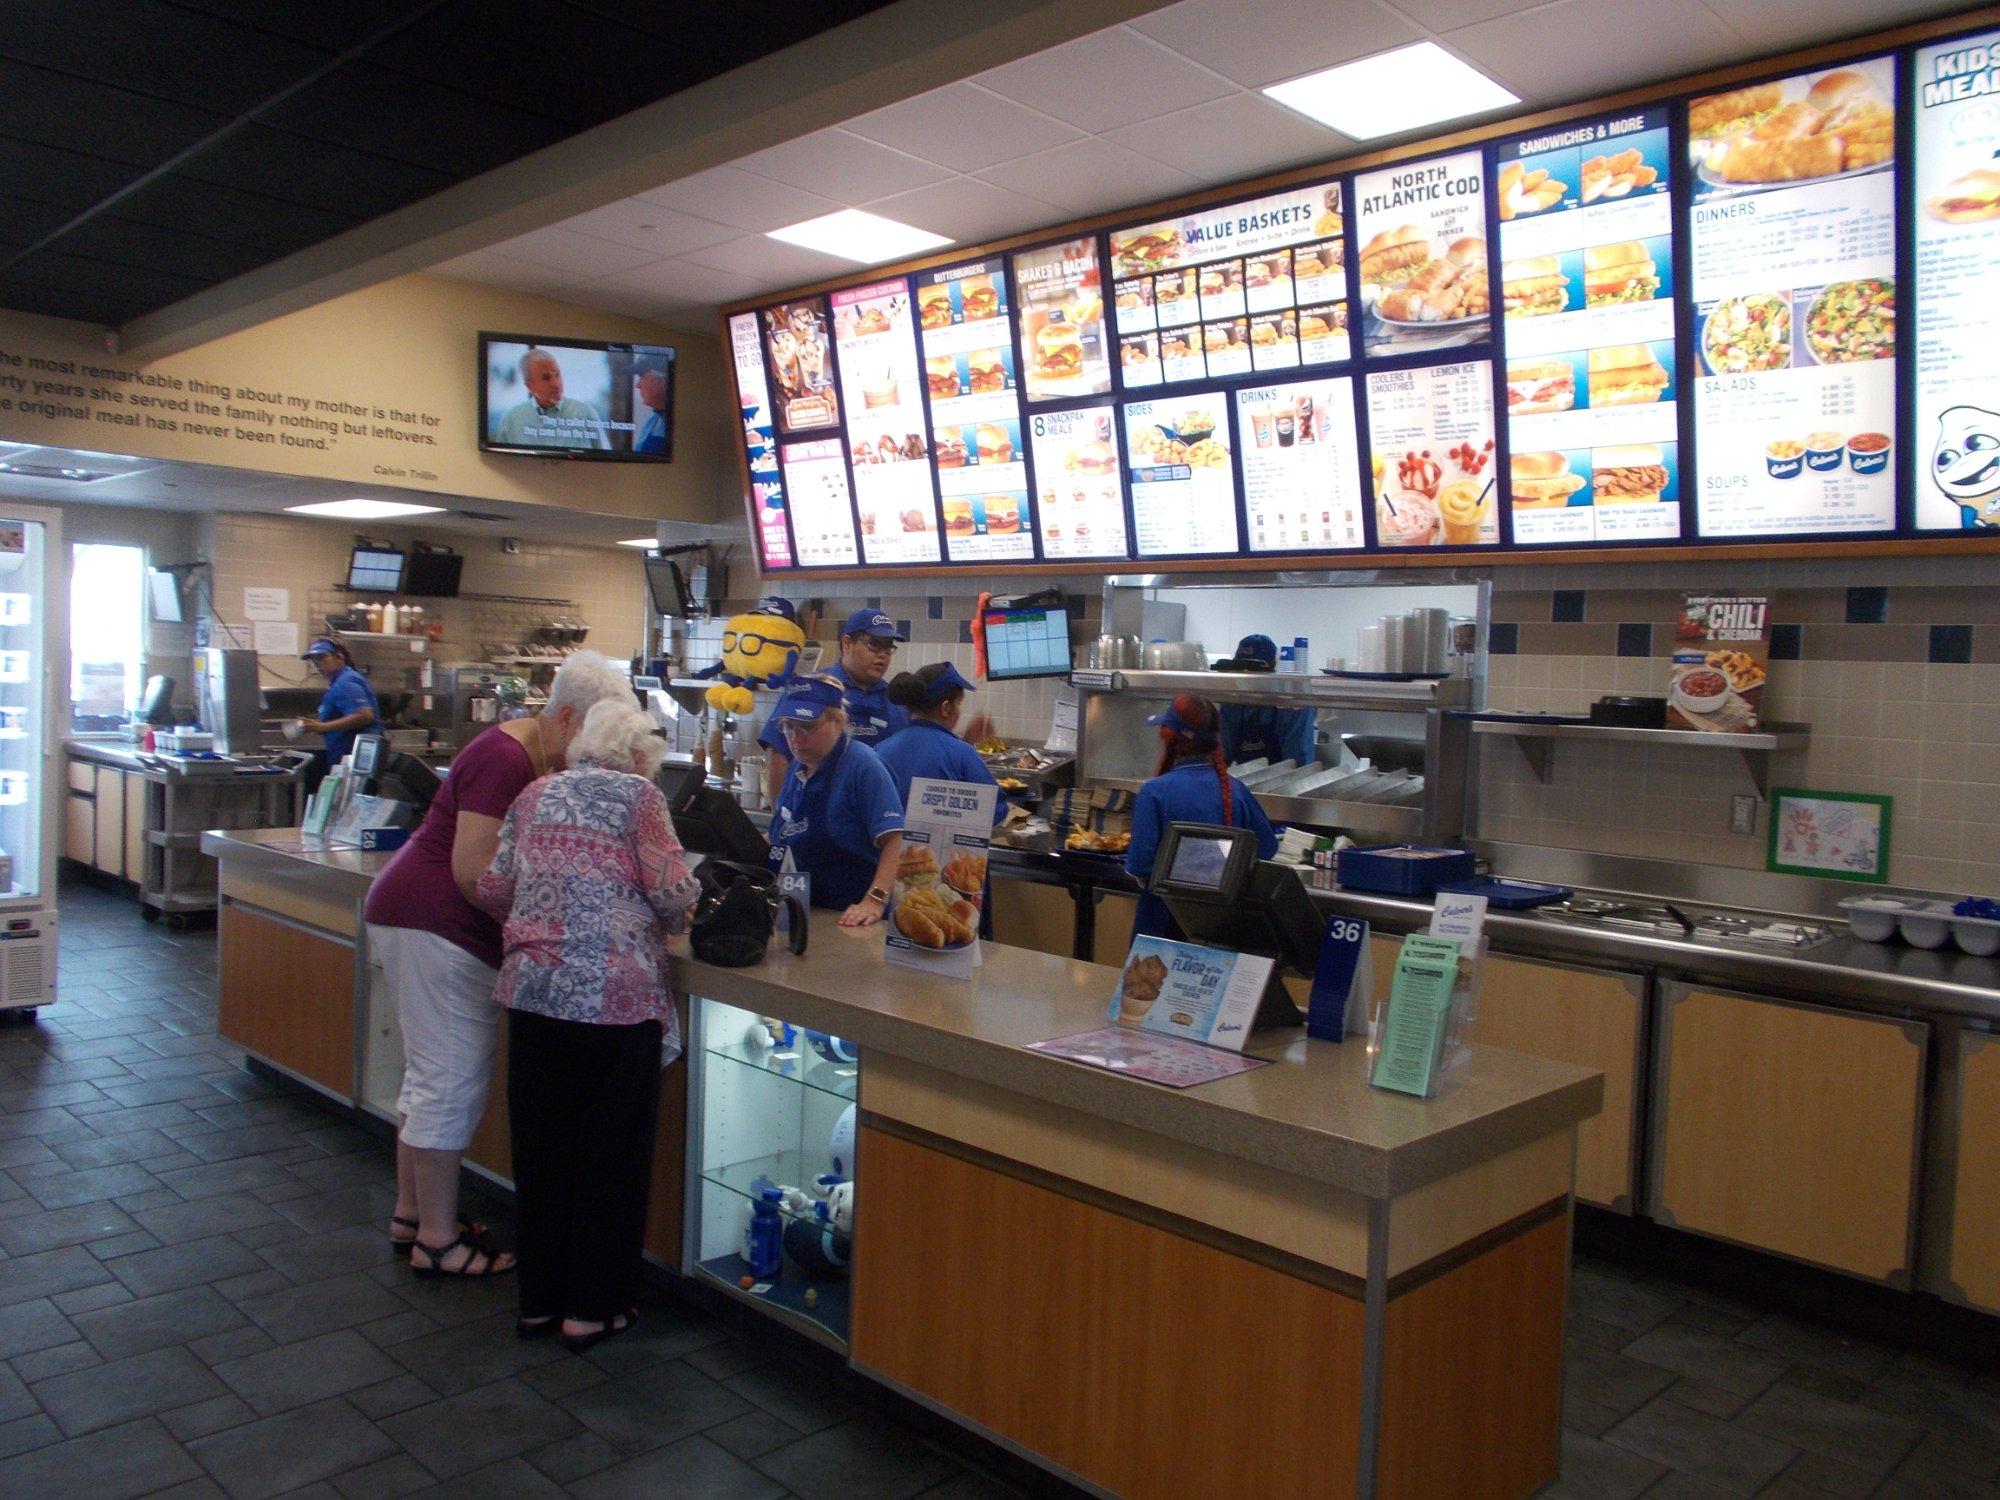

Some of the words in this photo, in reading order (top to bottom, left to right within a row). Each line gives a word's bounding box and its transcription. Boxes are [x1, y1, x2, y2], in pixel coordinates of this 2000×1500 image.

[1519, 126, 1594, 155] SANDWICHES
[1597, 125, 1606, 138] &
[1609, 116, 1645, 135] MORE
[1392, 166, 1447, 190] NORTH
[1362, 183, 1440, 216] ATLANTIC
[1445, 175, 1480, 196] COD
[1430, 205, 1469, 219] SANDWICH
[1696, 201, 1756, 224] DINNERS
[1186, 221, 1233, 244] VALUE
[1239, 204, 1312, 234] BASKETS
[1437, 226, 1464, 238] DINNER
[1017, 264, 1053, 284] SHAKES
[1062, 256, 1094, 275] BACON
[1370, 373, 1405, 385] COOLERS
[1430, 365, 1460, 378] LEMON
[1462, 363, 1476, 374] ICE
[28, 357, 76, 374] most
[81, 365, 183, 390] remarkable
[188, 378, 230, 400] thing
[236, 387, 282, 404] about
[288, 395, 310, 411] my
[314, 399, 368, 416] mother
[373, 406, 385, 419] is
[389, 409, 417, 424] that
[421, 413, 440, 427] for
[1370, 380, 1415, 394] SMOOTHIES
[1704, 377, 1757, 394] SALADS
[1240, 388, 1278, 404] DRINKS
[32, 380, 84, 398] years
[90, 386, 123, 403] she
[129, 393, 188, 412] served
[194, 401, 220, 416] the
[225, 405, 275, 426] family
[280, 414, 338, 435] nothing
[343, 421, 367, 436] but
[372, 425, 438, 445] leftovers.
[1127, 403, 1153, 417] SIDES
[19, 400, 90, 420] original
[96, 410, 139, 427] meal
[146, 414, 177, 431] has
[183, 421, 230, 437] never
[235, 426, 275, 443] been
[1034, 416, 1046, 437] 8
[1047, 422, 1073, 435] MEALS
[373, 465, 406, 477] Calvin
[1706, 475, 1750, 489] SOUPS
[1708, 604, 1766, 629] CHILI
[769, 846, 785, 861] 86
[783, 875, 806, 891] 84
[1330, 920, 1361, 942] 36
[1171, 958, 1206, 975] FLAVOR
[1200, 974, 1220, 988] DAY
